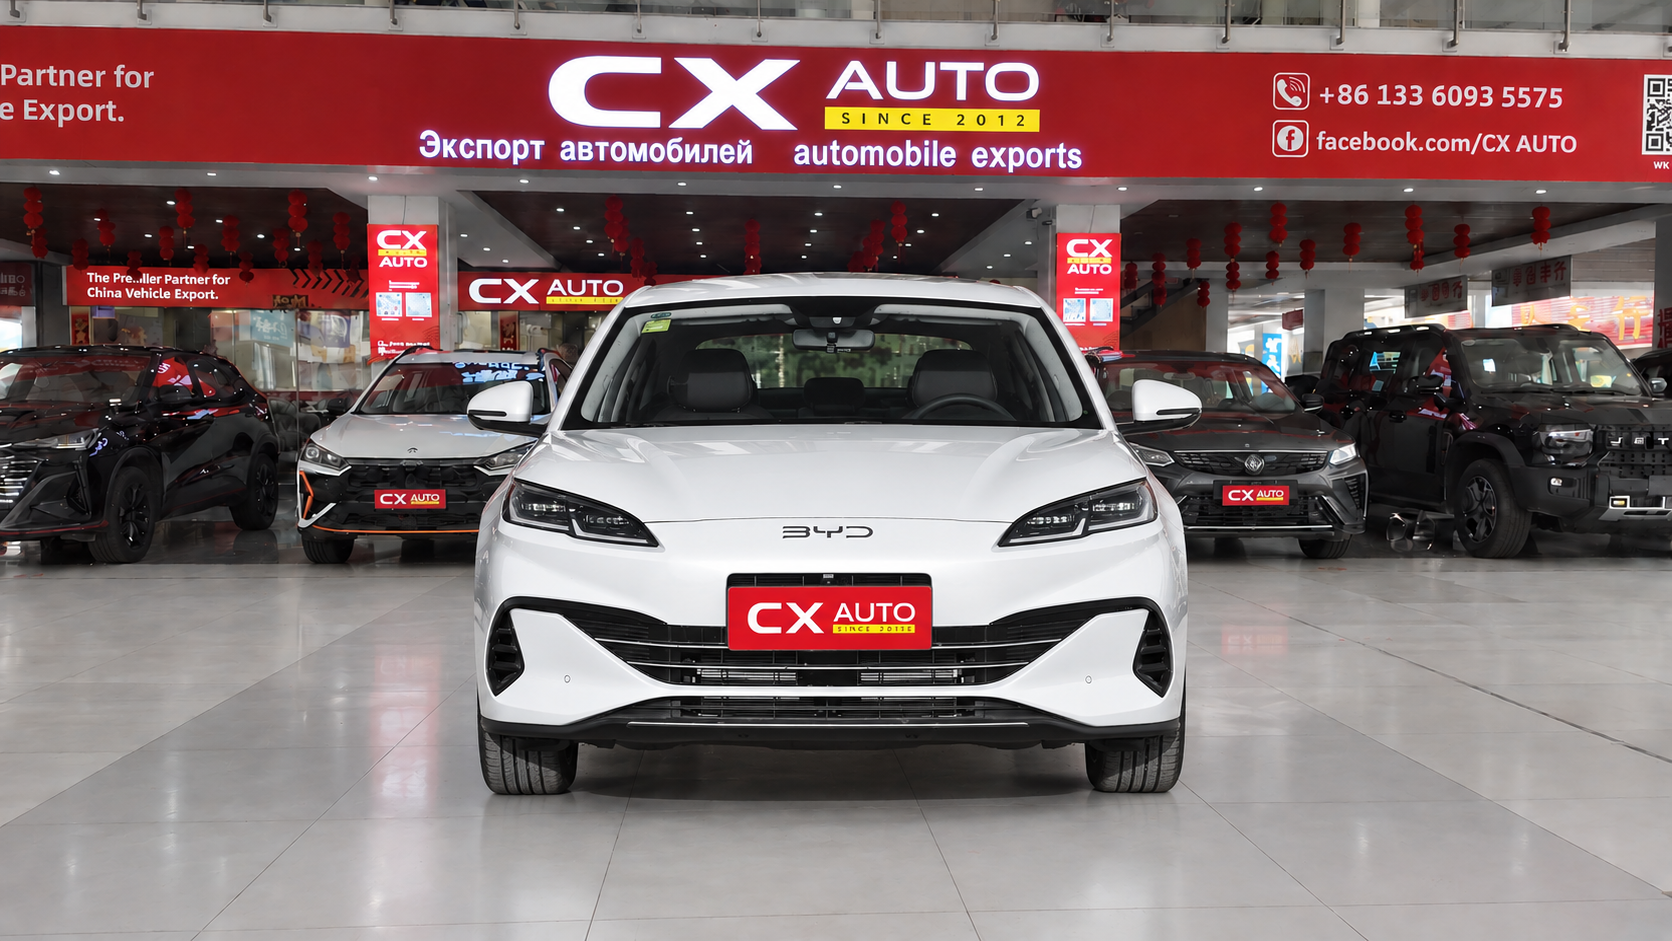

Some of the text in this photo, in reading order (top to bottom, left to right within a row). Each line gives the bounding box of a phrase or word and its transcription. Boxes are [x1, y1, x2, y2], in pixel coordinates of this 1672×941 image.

[1, 64, 154, 88] Partner for
[549, 56, 1040, 130] CX AUTO
[1319, 84, 1563, 108] +86 133 6093 5575
[23, 99, 124, 127] Export.
[841, 112, 1025, 127] SINCE 2012
[418, 129, 753, 165] Экспорт автомобилей
[1316, 129, 1577, 155] facebook.com/CX AUTO
[793, 140, 1082, 173] automobile exports
[376, 229, 427, 250] CX
[1066, 238, 1113, 258] CX
[378, 256, 428, 268] AUTO
[1067, 264, 1113, 275] AUTO
[86, 272, 109, 284] The
[164, 274, 210, 286] Partner
[212, 274, 231, 285] for
[86, 287, 219, 302] China Vehicle Export.
[469, 278, 624, 305] CX AUTO
[379, 493, 440, 505] CX AUTO
[1228, 489, 1285, 502] CX AUTO
[782, 525, 874, 539] BYD
[747, 602, 916, 634] CX AUTO
